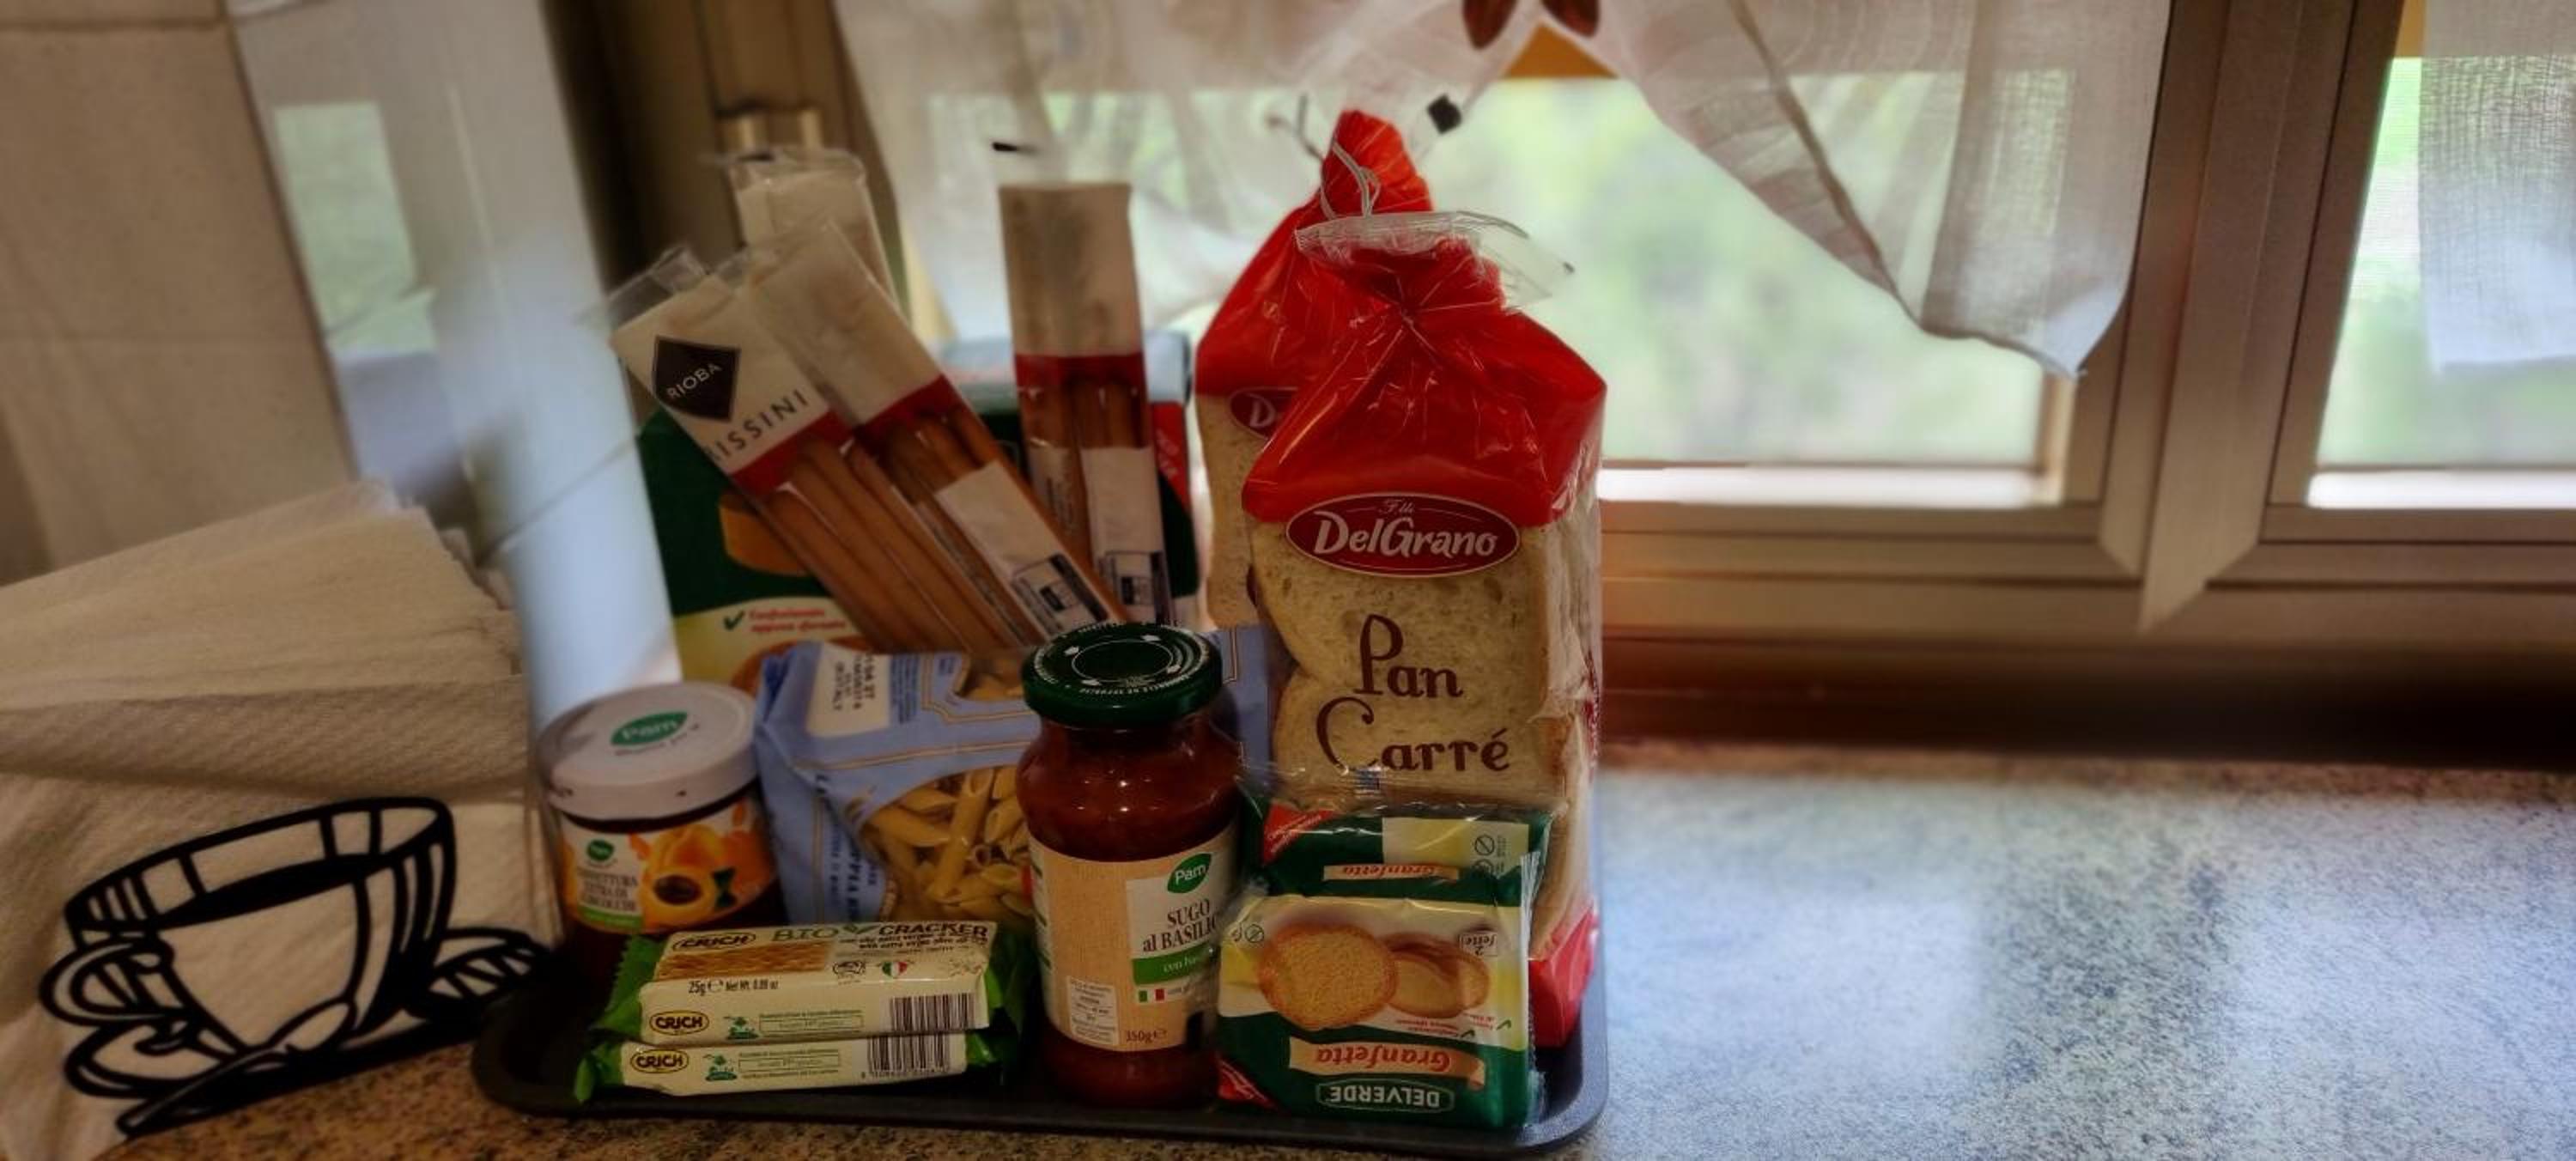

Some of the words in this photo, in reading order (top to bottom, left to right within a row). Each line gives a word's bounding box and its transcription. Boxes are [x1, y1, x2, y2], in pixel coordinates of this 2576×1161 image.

[666, 362, 723, 400] RIOBA
[1313, 510, 1499, 558] DelGrano
[1353, 613, 1464, 698] Pan
[1316, 696, 1510, 772] Carré
[1175, 862, 1206, 885] Pam
[1167, 899, 1211, 927] SUGO
[677, 934, 750, 946] CRICH
[878, 922, 987, 937] CRACKER
[1143, 933, 1157, 951] al
[1465, 934, 1496, 947] fette
[689, 980, 706, 996] 25g
[655, 1015, 702, 1030] CRICH
[635, 1054, 683, 1068] CRICH
[1315, 1045, 1452, 1073] Granfetta
[1329, 1085, 1443, 1109] DELVERDE
